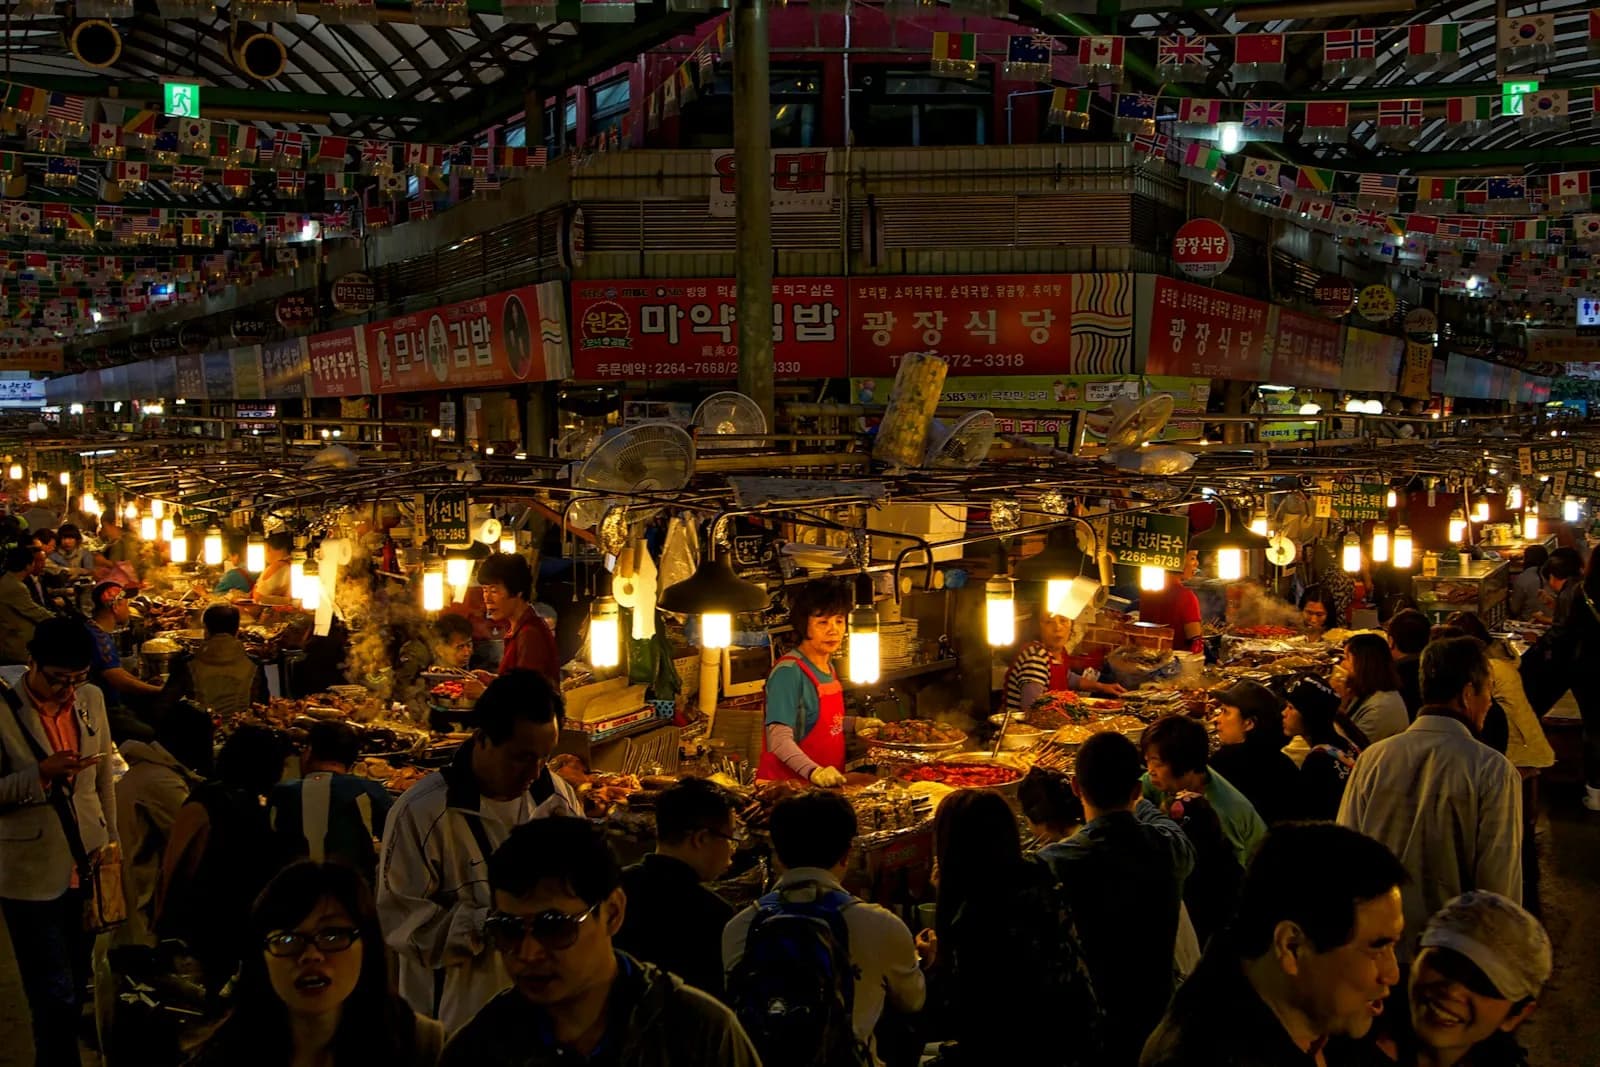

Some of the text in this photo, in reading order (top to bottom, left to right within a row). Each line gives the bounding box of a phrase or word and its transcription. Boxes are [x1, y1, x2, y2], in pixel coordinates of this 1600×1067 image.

[1175, 237, 1226, 256] 광장식당
[337, 285, 376, 301] 마약김밥
[585, 311, 628, 334] 원조
[861, 308, 1057, 347] 광장식당
[394, 327, 429, 374] 모녀
[449, 314, 493, 369] 김밥
[1168, 317, 1254, 361] 광장식당
[947, 392, 966, 401] SBS
[1113, 515, 1147, 529] 하니네
[1111, 527, 1134, 548] 순대
[1137, 531, 1184, 554] 잔치국수
[1119, 549, 1181, 568] 2268-6738
